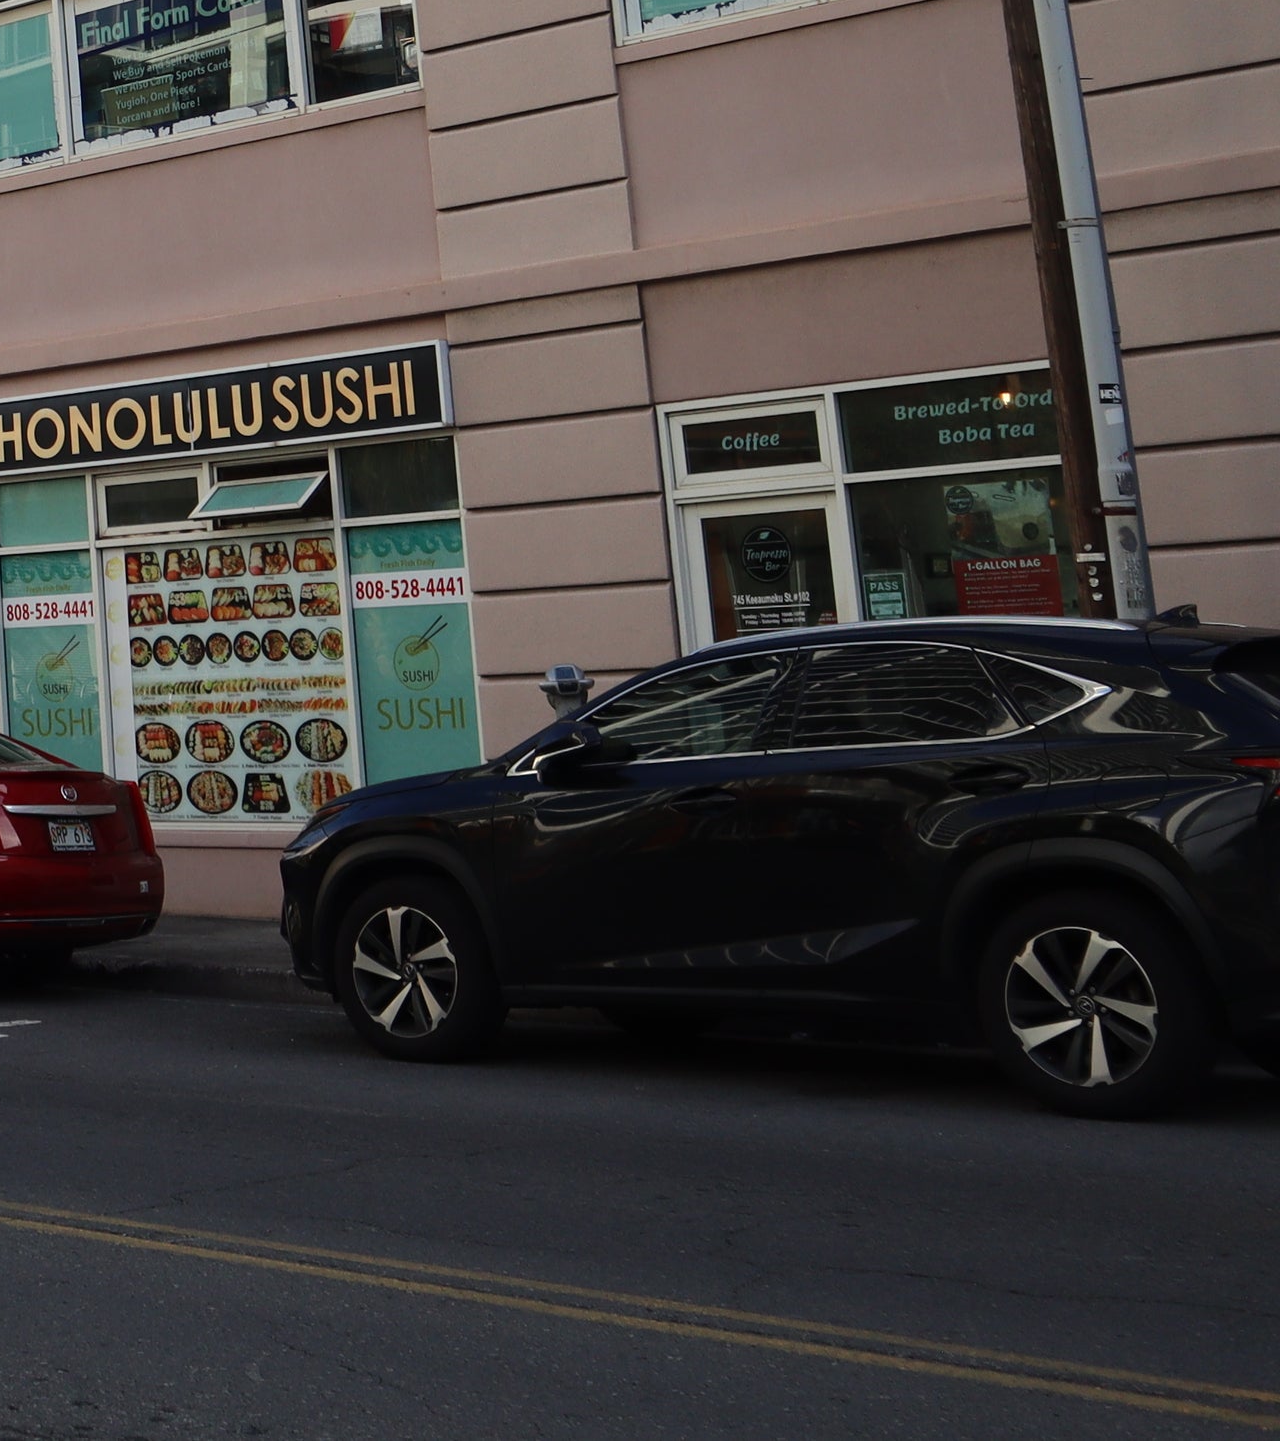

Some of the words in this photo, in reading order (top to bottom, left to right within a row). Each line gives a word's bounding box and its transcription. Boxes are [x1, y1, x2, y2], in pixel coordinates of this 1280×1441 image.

[80, 10, 129, 49] Final
[136, 4, 189, 36] Form
[113, 70, 127, 80] We
[128, 66, 145, 79] Buy
[147, 61, 163, 72] and
[164, 57, 182, 69] Sell
[184, 46, 226, 64] Pokemon
[114, 84, 128, 95] We
[129, 81, 149, 92] Also
[150, 74, 174, 89] Carry
[176, 67, 206, 84] Sports
[115, 95, 149, 110] Yugioh,
[151, 91, 169, 102] One
[170, 85, 197, 99] Piece,
[117, 109, 152, 125] Lorcana
[153, 106, 170, 117] and
[721, 432, 780, 452] Coffee
[939, 425, 991, 445] Boba
[997, 423, 1035, 439] Tea
[746, 548, 788, 563] Teapresso
[967, 559, 1017, 571] 1-GALLON
[1019, 558, 1041, 568] BAG
[765, 561, 780, 572] Bar
[355, 576, 465, 600] 808-528-4441
[870, 581, 899, 592] PASS
[732, 594, 745, 605] 745
[6, 600, 95, 622] 808-528-4441
[402, 670, 434, 683] SUSHI
[43, 683, 69, 695] SUSHI
[22, 707, 94, 737] SUSHI
[377, 696, 466, 731] SUSHI
[51, 825, 68, 845] SRP
[73, 825, 92, 845] 613
